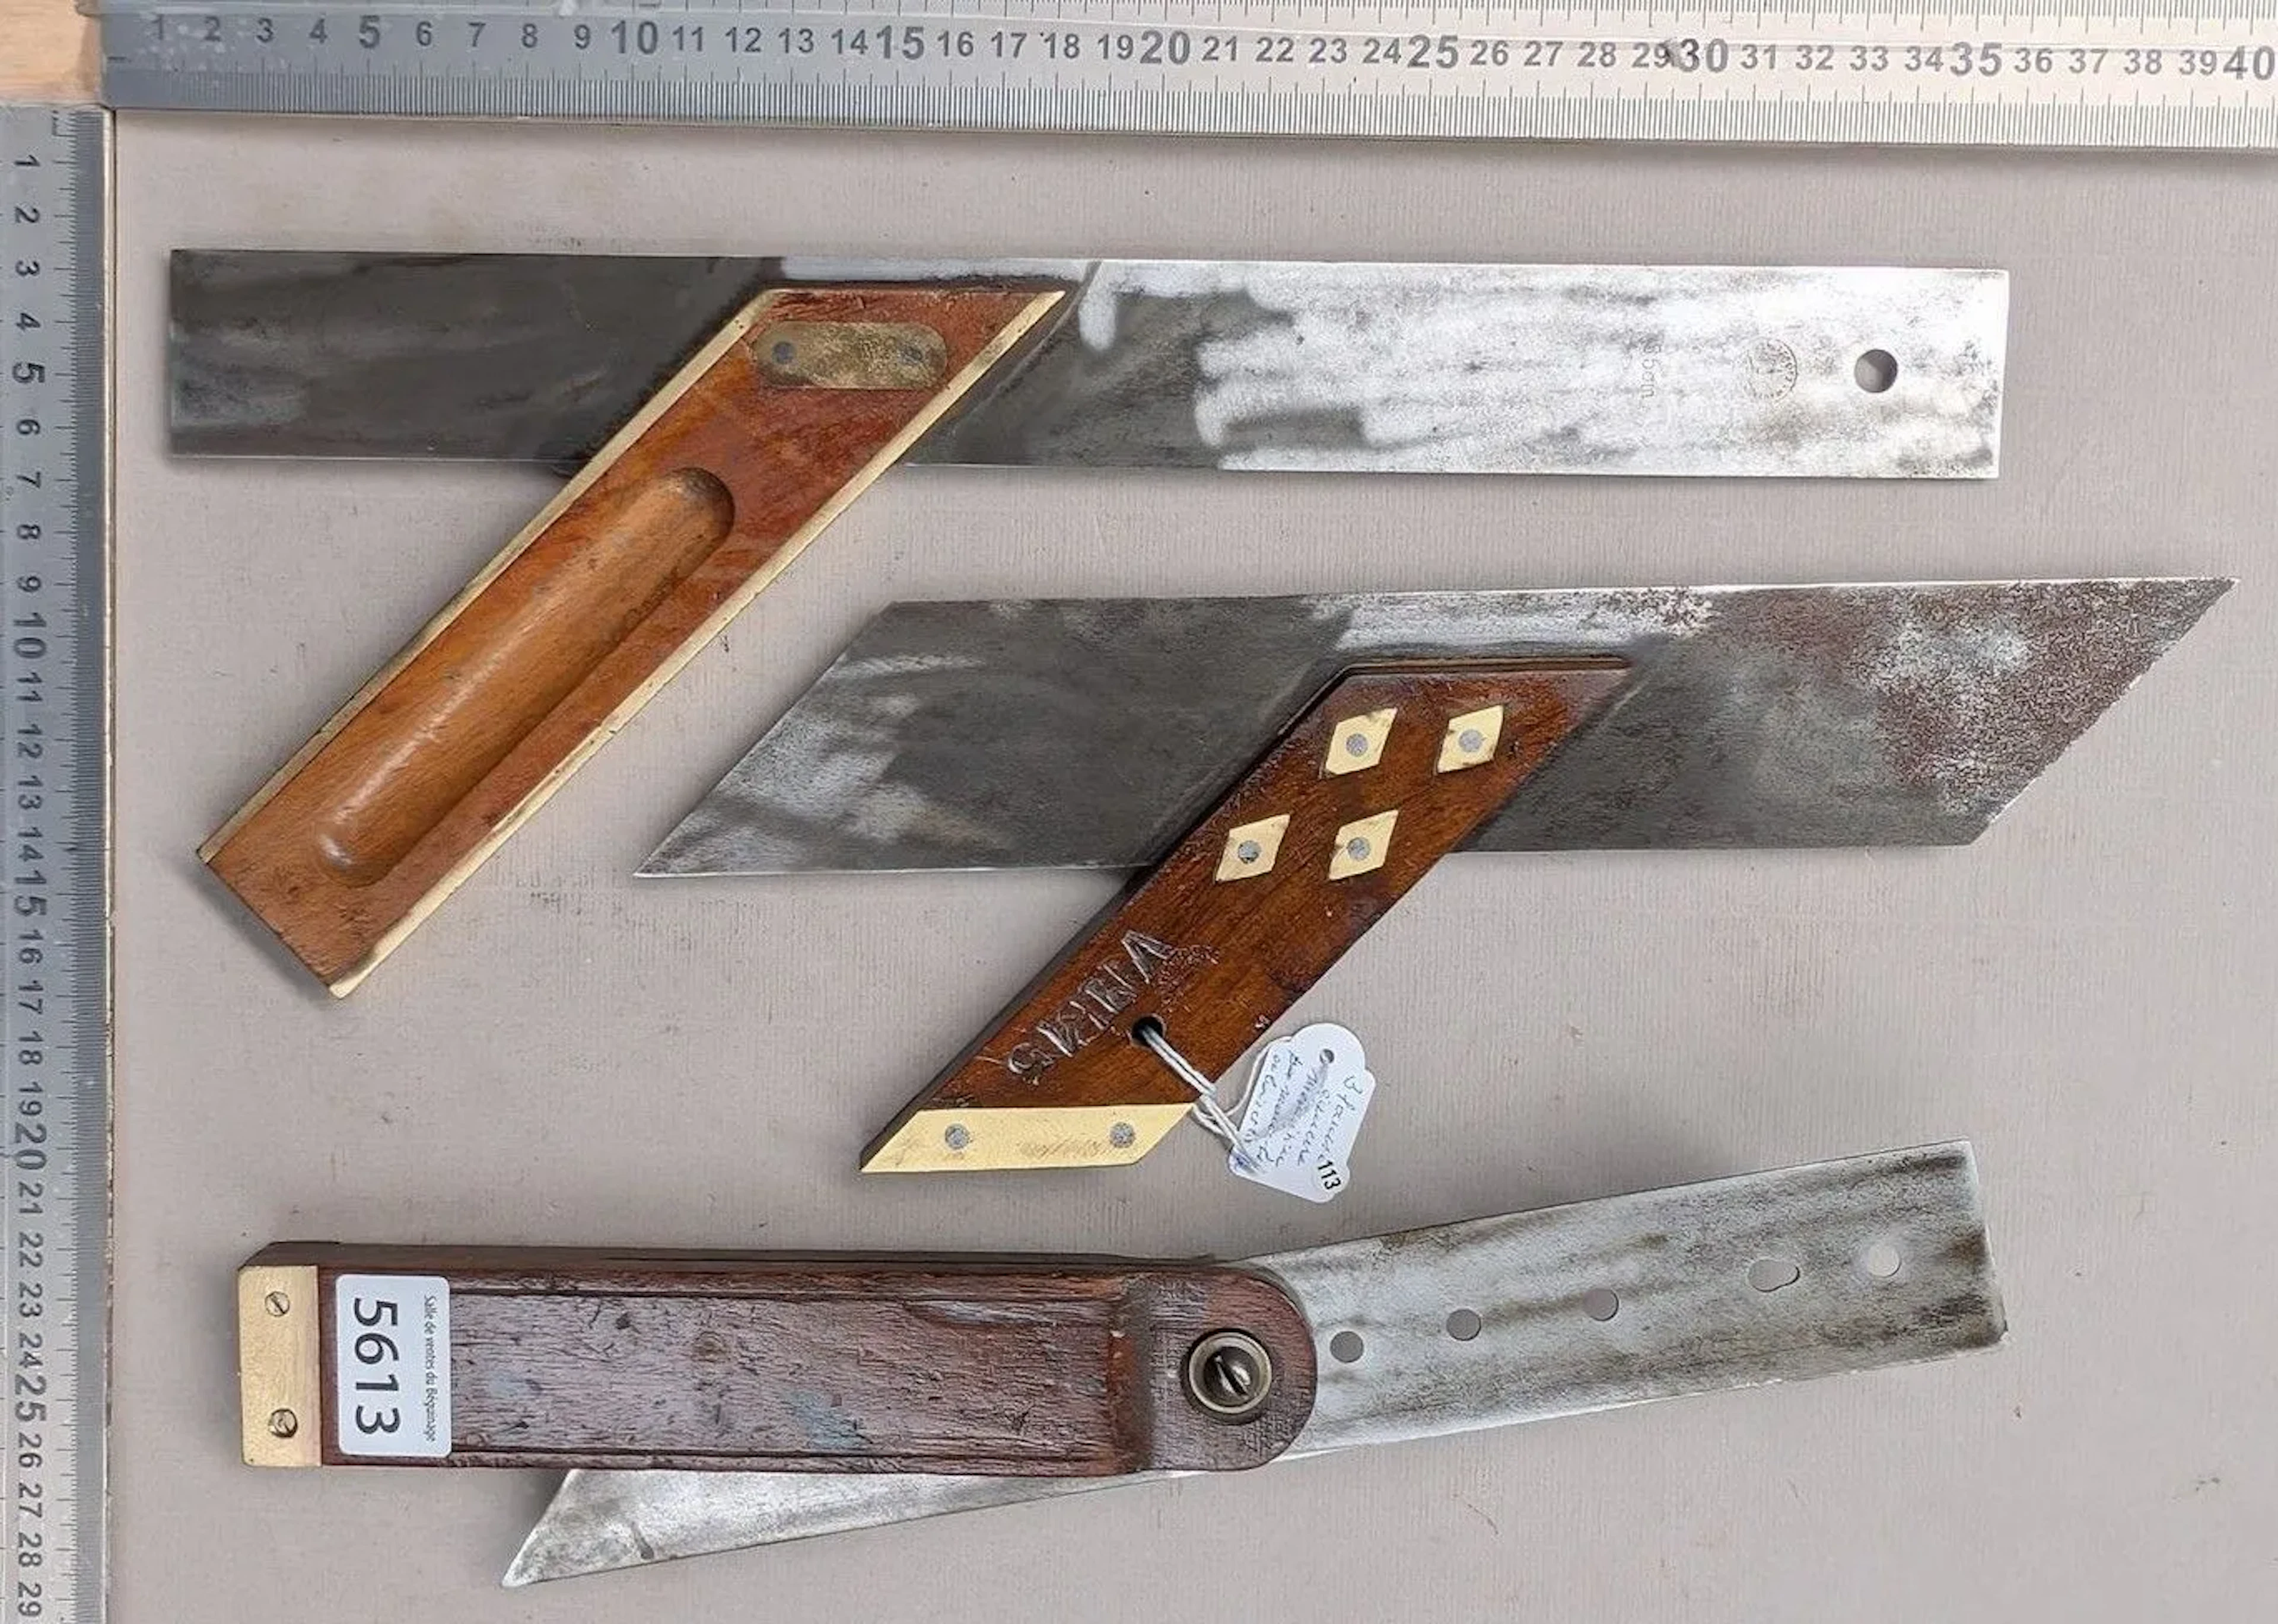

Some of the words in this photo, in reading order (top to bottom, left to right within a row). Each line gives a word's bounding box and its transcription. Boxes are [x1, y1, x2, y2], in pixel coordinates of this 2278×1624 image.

[204, 17, 222, 41] 2
[255, 18, 275, 44] 3
[309, 20, 328, 44] 4
[359, 15, 381, 49] 5
[415, 21, 434, 47] 6
[468, 22, 487, 48] 7
[521, 23, 539, 48] 8
[572, 25, 592, 50] 9
[610, 20, 660, 55] 10
[672, 26, 704, 52] 11
[725, 26, 762, 53] 12
[778, 27, 815, 55] 13
[831, 27, 869, 55] 14
[876, 26, 925, 61] 15
[937, 30, 975, 58] 16
[990, 32, 1027, 59] 17
[1043, 32, 1080, 59] 18
[1097, 34, 1135, 61] 19
[1139, 30, 1190, 65] 20
[1202, 36, 1239, 62] 21
[1255, 37, 1294, 63] 22
[1309, 37, 1347, 64] 23
[1362, 39, 1401, 65] 24
[1407, 34, 1459, 69] 25
[1470, 39, 1509, 66] 26
[1524, 40, 1563, 66] 27
[1577, 41, 1617, 68] 28
[1631, 42, 1670, 69] 29
[1675, 39, 1730, 74] 30
[1741, 43, 1777, 71] 31
[1795, 44, 1835, 71] 32
[1850, 45, 1889, 72] 33
[1904, 46, 1944, 72] 34
[1949, 42, 2003, 77] 35
[2013, 47, 2054, 74] 36
[2069, 49, 2108, 75] 37
[2123, 49, 2163, 75] 38
[2178, 49, 2218, 77] 39
[2223, 45, 2276, 80] 40
[14, 154, 41, 167] 1
[14, 206, 41, 224] 2
[15, 260, 40, 278] 3
[15, 312, 42, 331] 4
[11, 361, 46, 384] 5
[15, 418, 42, 436] 6
[15, 471, 42, 490] 7
[15, 524, 42, 541] 8
[16, 575, 42, 593] 9
[13, 612, 47, 660] 10
[16, 672, 43, 705] 11
[16, 723, 43, 759] 12
[17, 775, 43, 811] 13
[17, 826, 44, 862] 14
[14, 870, 48, 917] 15
[18, 929, 44, 964] 16
[18, 979, 44, 1014] 17
[18, 1030, 44, 1066] 18
[18, 1081, 44, 1117] 19
[14, 1123, 48, 1171] 20
[1318, 1161, 1341, 1190] 113
[18, 1182, 44, 1214] 21
[18, 1231, 44, 1268] 22
[18, 1282, 43, 1318] 23
[424, 1295, 439, 1320] Salle
[424, 1322, 437, 1335] de
[18, 1332, 43, 1368] 24
[354, 1297, 401, 1435] 5613
[424, 1337, 437, 1370] ventes
[426, 1372, 438, 1386] du
[14, 1374, 47, 1422] 25
[423, 1388, 439, 1443] Béguinage
[18, 1432, 43, 1468] 26
[17, 1482, 43, 1518] 27
[17, 1532, 43, 1568] 28
[17, 1581, 43, 1617] 29
